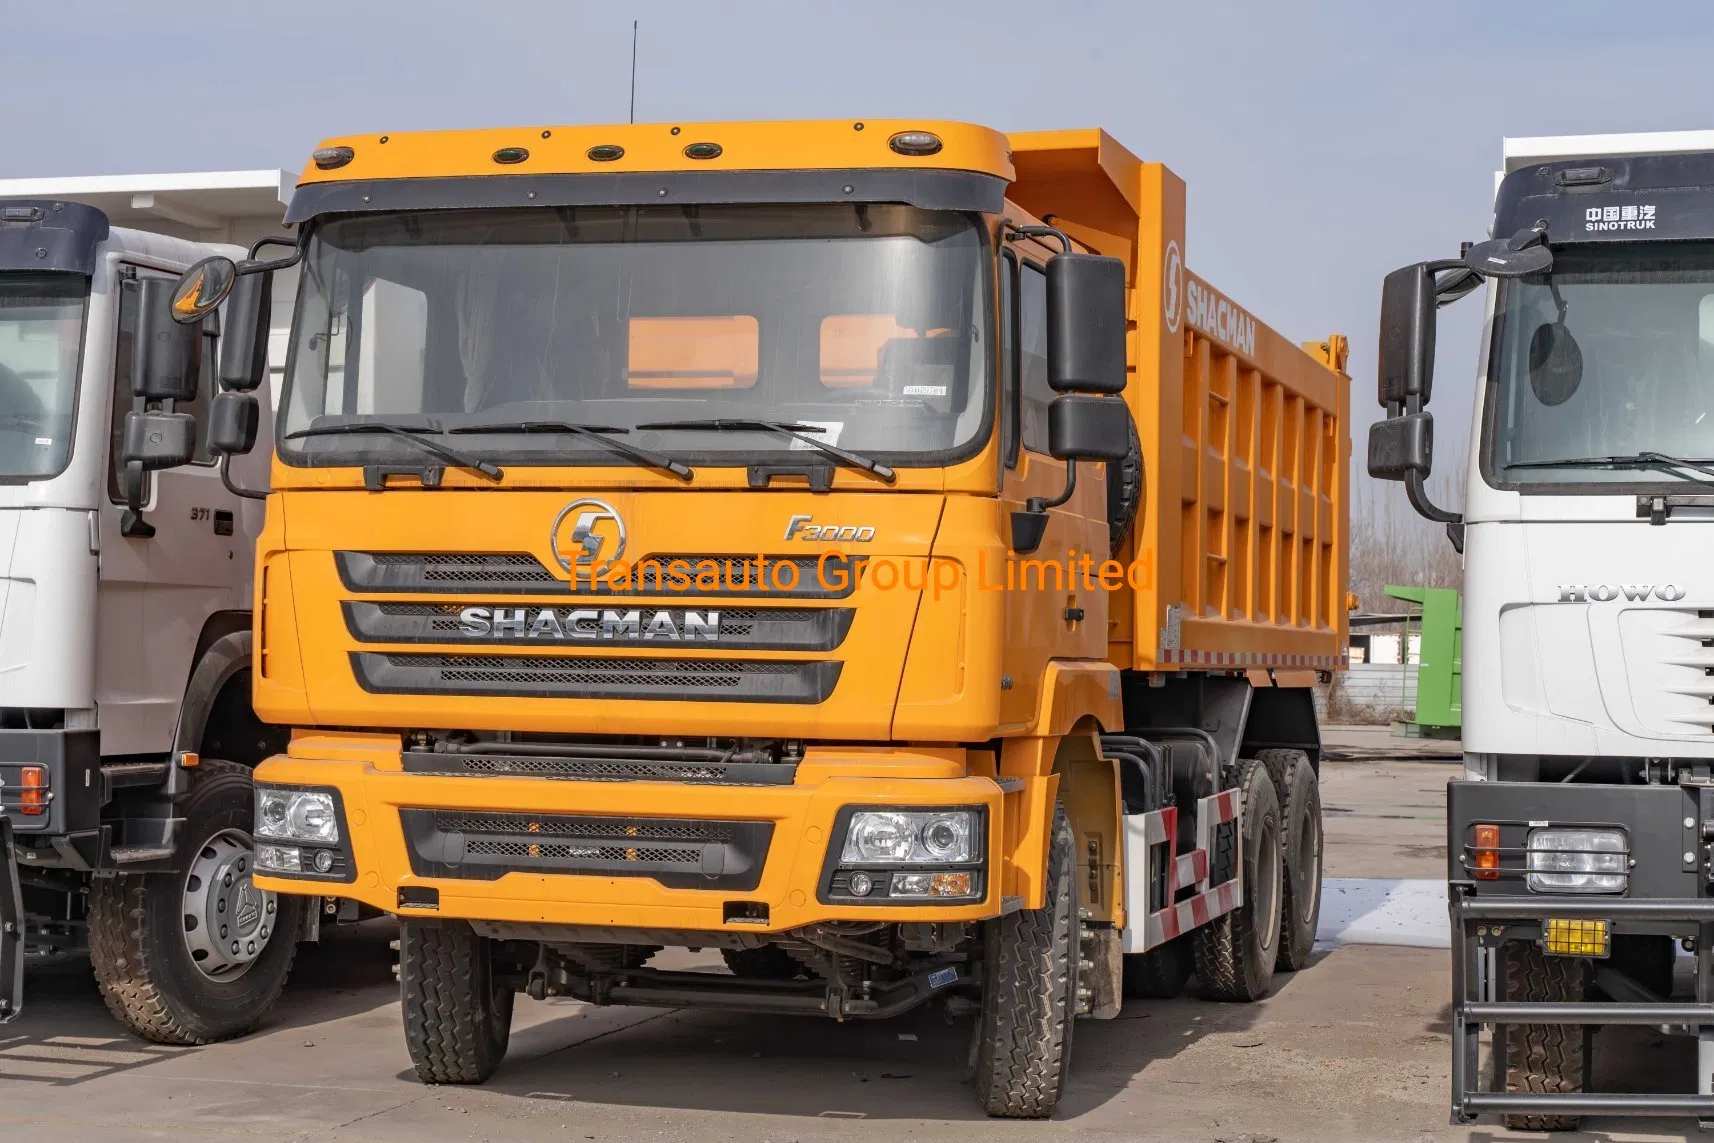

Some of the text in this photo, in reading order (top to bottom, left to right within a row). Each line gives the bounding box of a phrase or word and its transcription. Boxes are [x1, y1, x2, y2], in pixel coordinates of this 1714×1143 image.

[1585, 204, 1656, 222] 中国重汽
[1585, 220, 1656, 231] SINOTRUK
[1186, 279, 1257, 358] SHACMAN
[190, 507, 210, 520] 371
[784, 514, 876, 543] F3000
[1557, 584, 1687, 602] HOWO
[458, 607, 722, 642] SHACMAN
